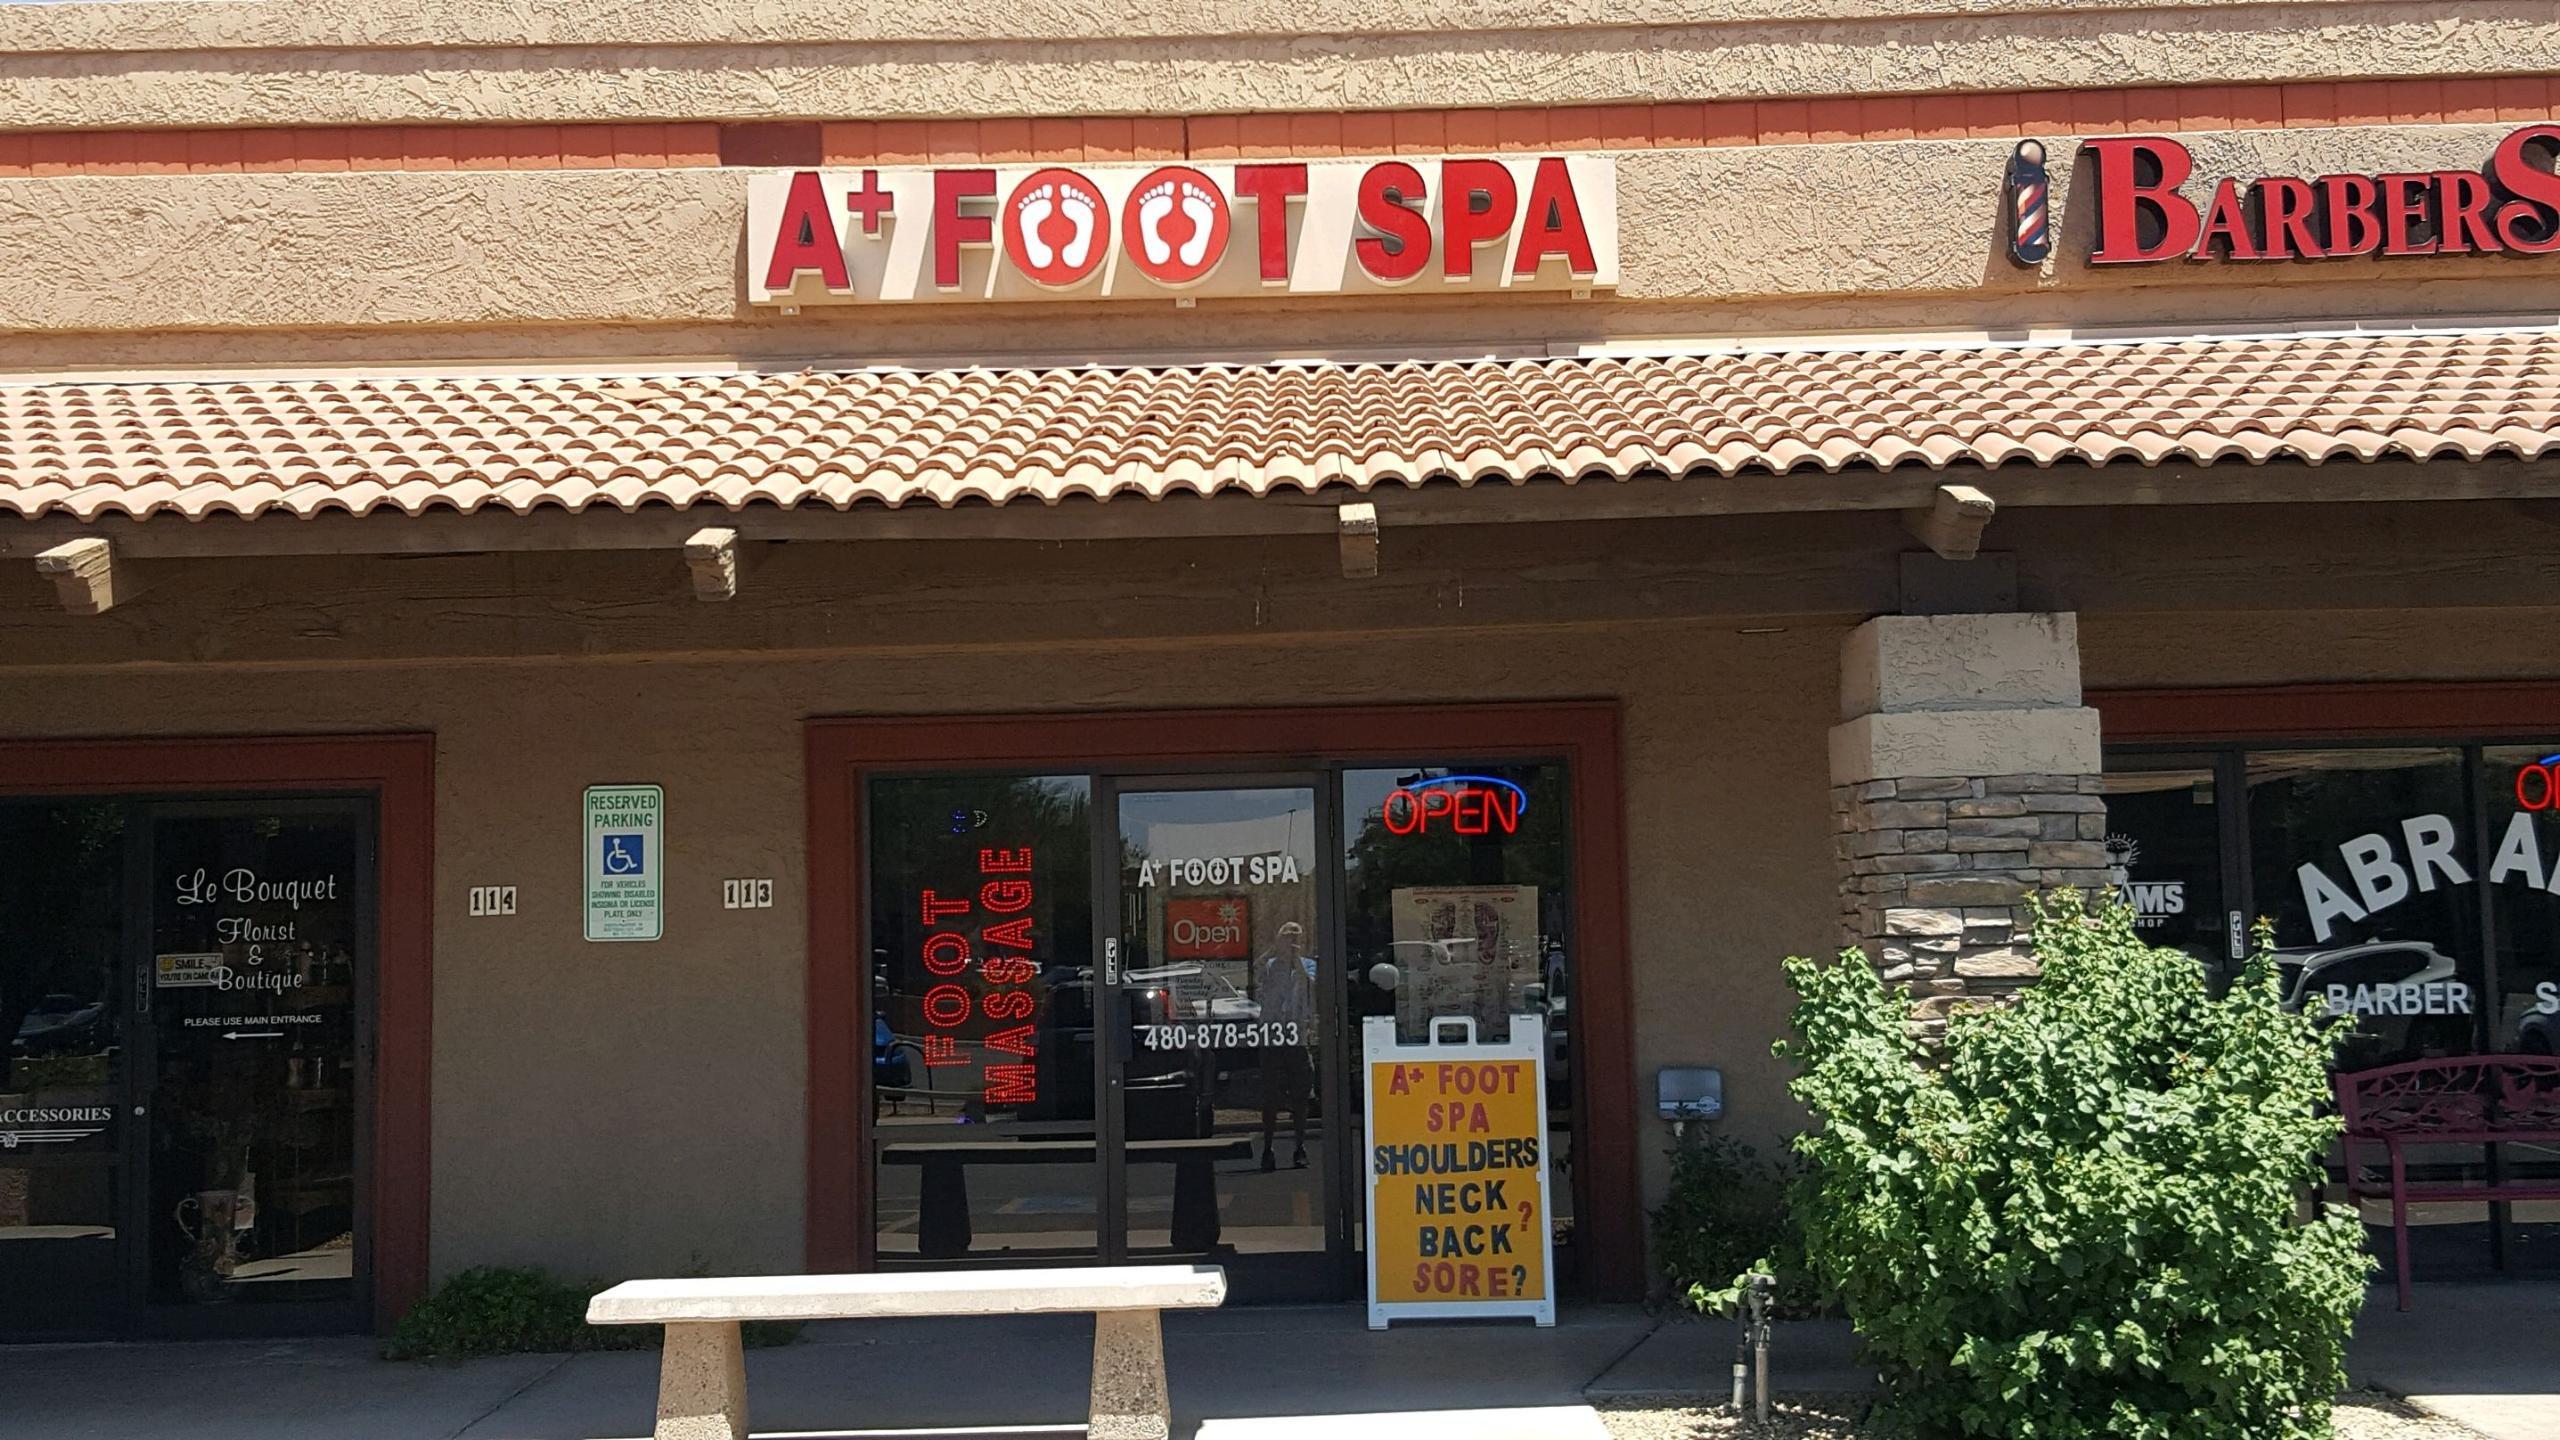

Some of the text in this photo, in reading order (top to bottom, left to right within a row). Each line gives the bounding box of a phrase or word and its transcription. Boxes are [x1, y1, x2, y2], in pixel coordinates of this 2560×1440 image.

[763, 157, 1597, 295] A+ FOOT SPA
[591, 795, 656, 810] RESERVED
[1383, 788, 1520, 836] OPEN
[594, 813, 653, 828] PARKING
[1138, 855, 1299, 887] A+ FOOT SPA
[176, 868, 337, 910] Le Bouquet
[472, 889, 514, 911] 114
[727, 883, 770, 904] 113
[604, 909, 642, 918] PLATE ONLY
[216, 918, 296, 944] Florist
[1173, 919, 1239, 949] Open
[2233, 914, 2242, 947] PULL
[175, 959, 204, 970] SMILE
[248, 944, 264, 965] &
[208, 966, 302, 995] Boutique
[921, 890, 973, 1067] FOOT
[979, 847, 1037, 1104] MASSAGE
[2327, 982, 2470, 1015] BARBER
[184, 1014, 322, 1027] PLEASE USE MAIN ENTRANCE
[1144, 1021, 1299, 1051] 480-878-5133
[1389, 1064, 1520, 1096] A+ FOOT
[0, 1107, 112, 1123] CCESSORIES
[1427, 1101, 1490, 1133] SPA
[1374, 1136, 1540, 1175] SHOULDERS
[1415, 1179, 1508, 1215] NECK
[1419, 1223, 1513, 1258] BACK
[1412, 1261, 1527, 1297] SORE?
